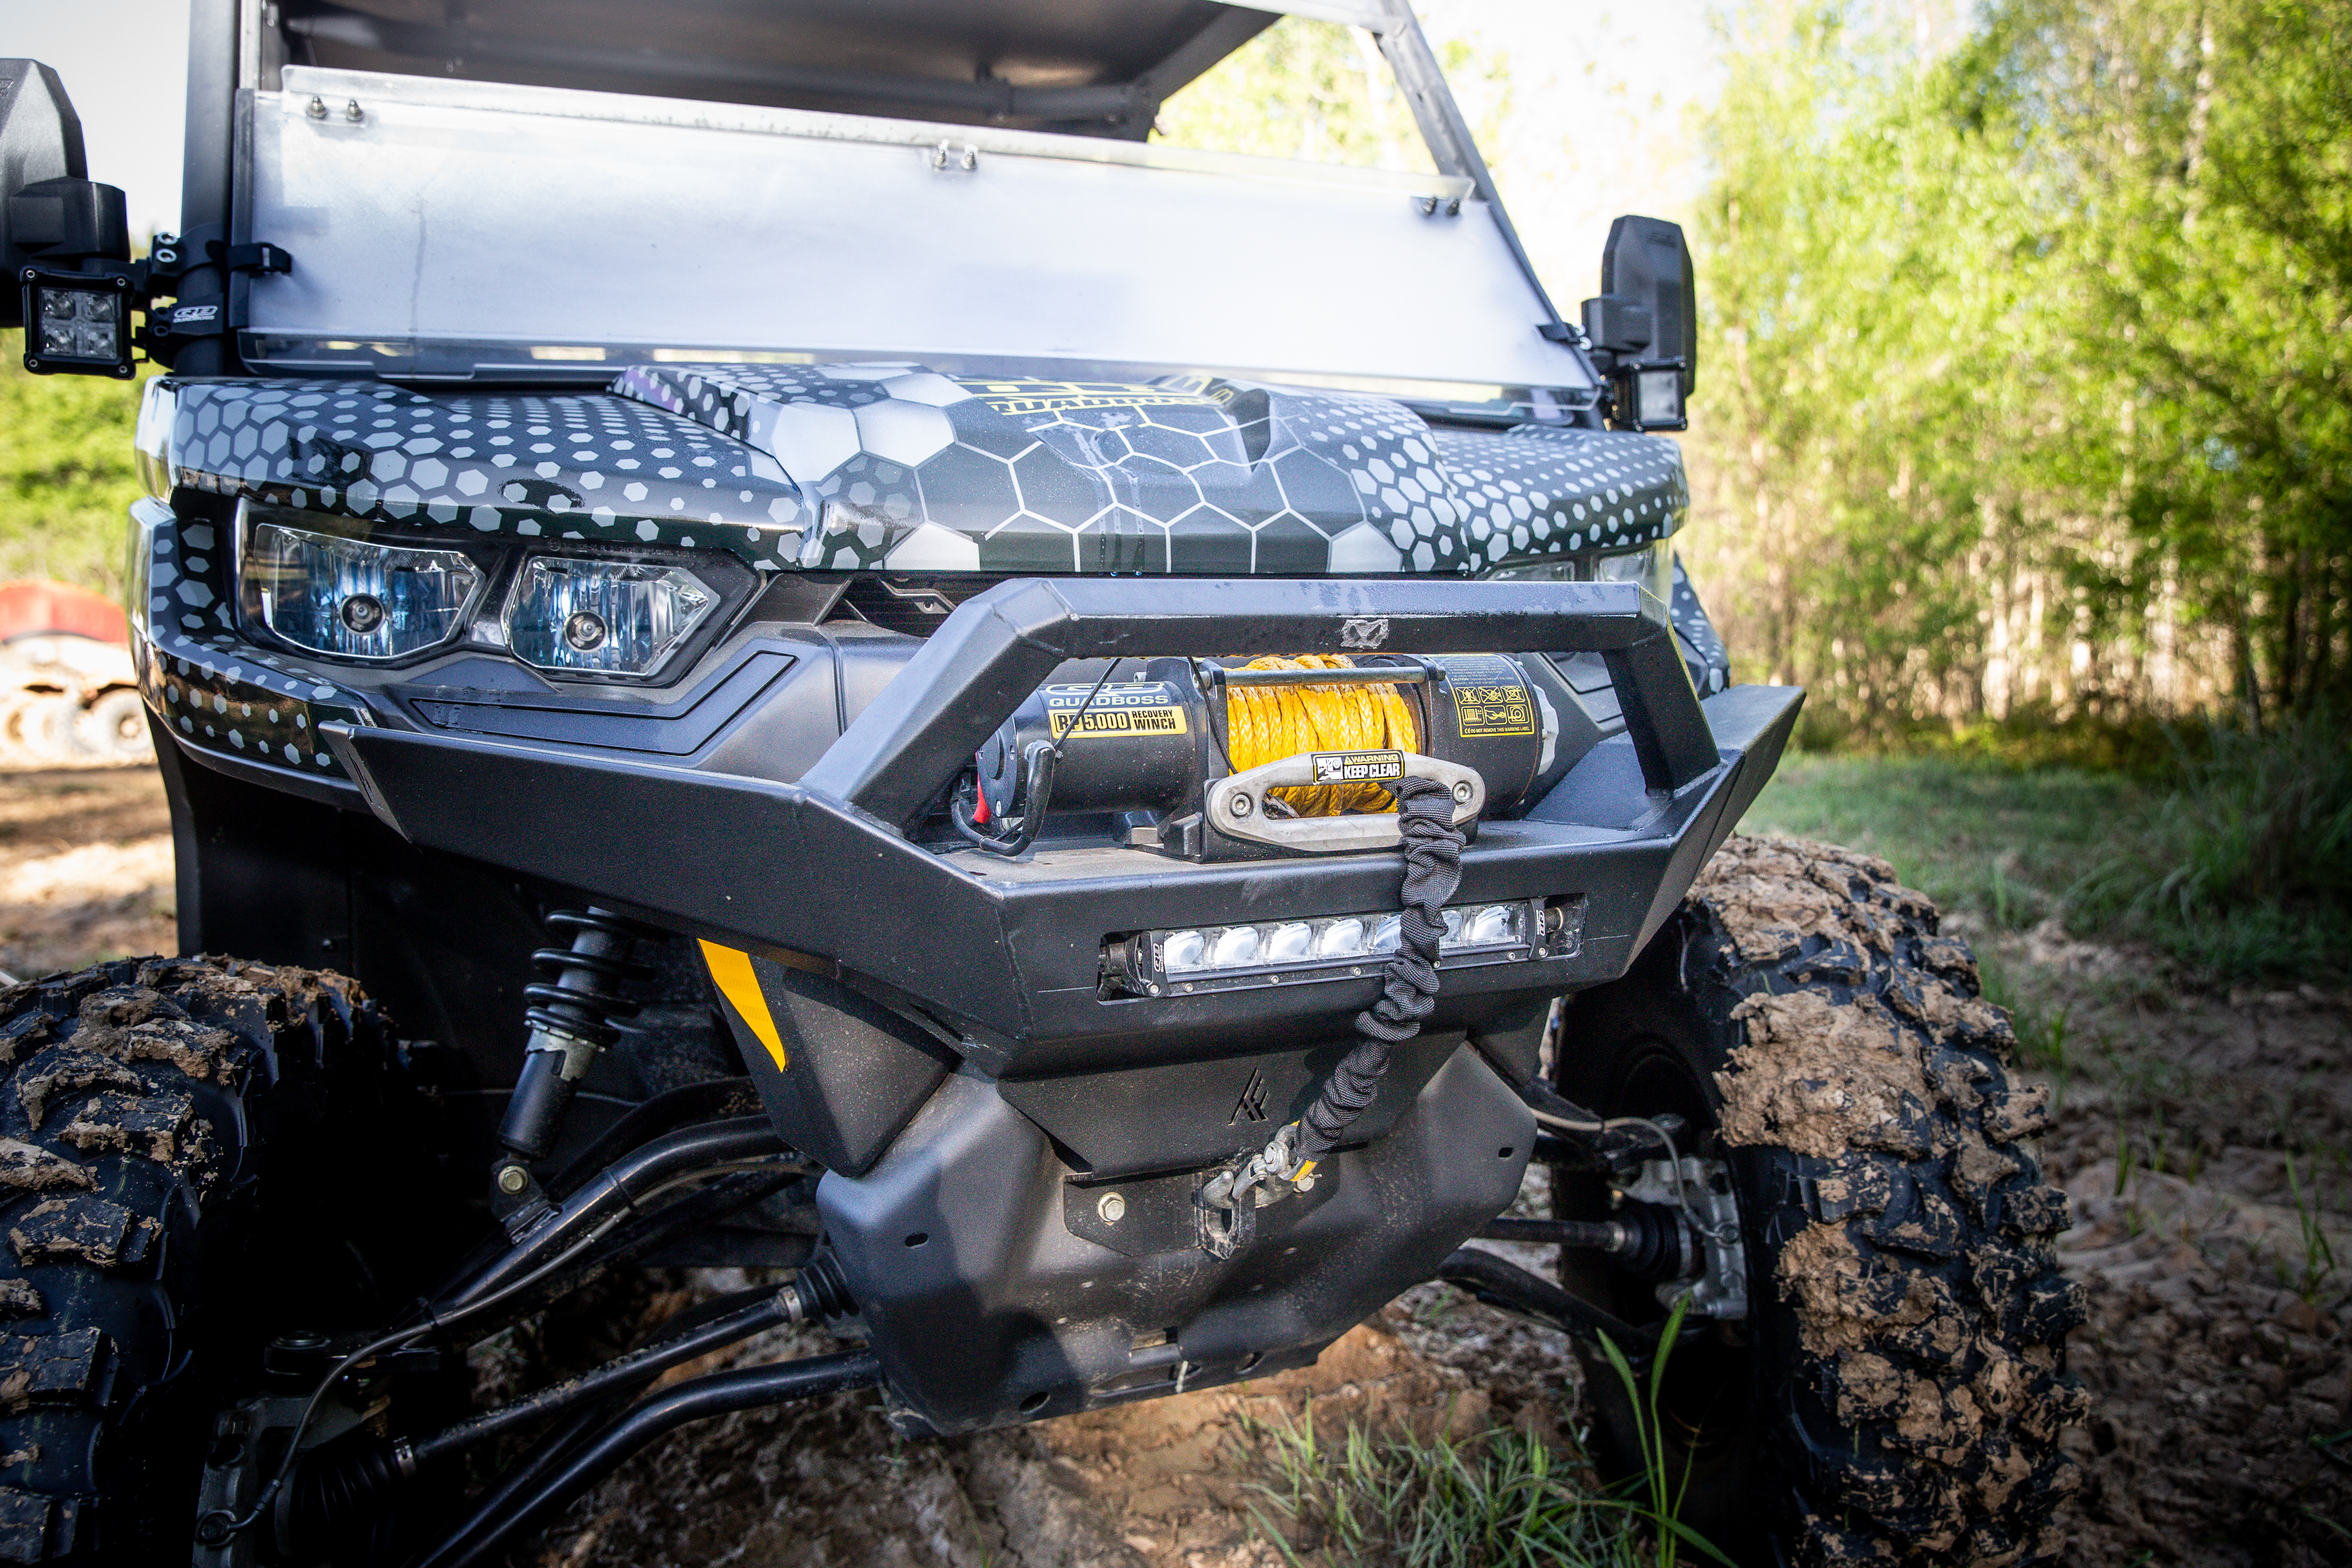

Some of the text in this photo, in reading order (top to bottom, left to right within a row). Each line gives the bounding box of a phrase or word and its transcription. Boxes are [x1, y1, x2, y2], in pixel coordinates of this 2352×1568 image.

[1049, 696, 1168, 707] QUADBOSS
[1131, 710, 1173, 718] RECOVERY
[1084, 713, 1128, 731] 5,000
[1134, 718, 1176, 731] WINCH
[1351, 754, 1399, 763] WARNING
[1344, 763, 1400, 779] KEEP CLEAR
